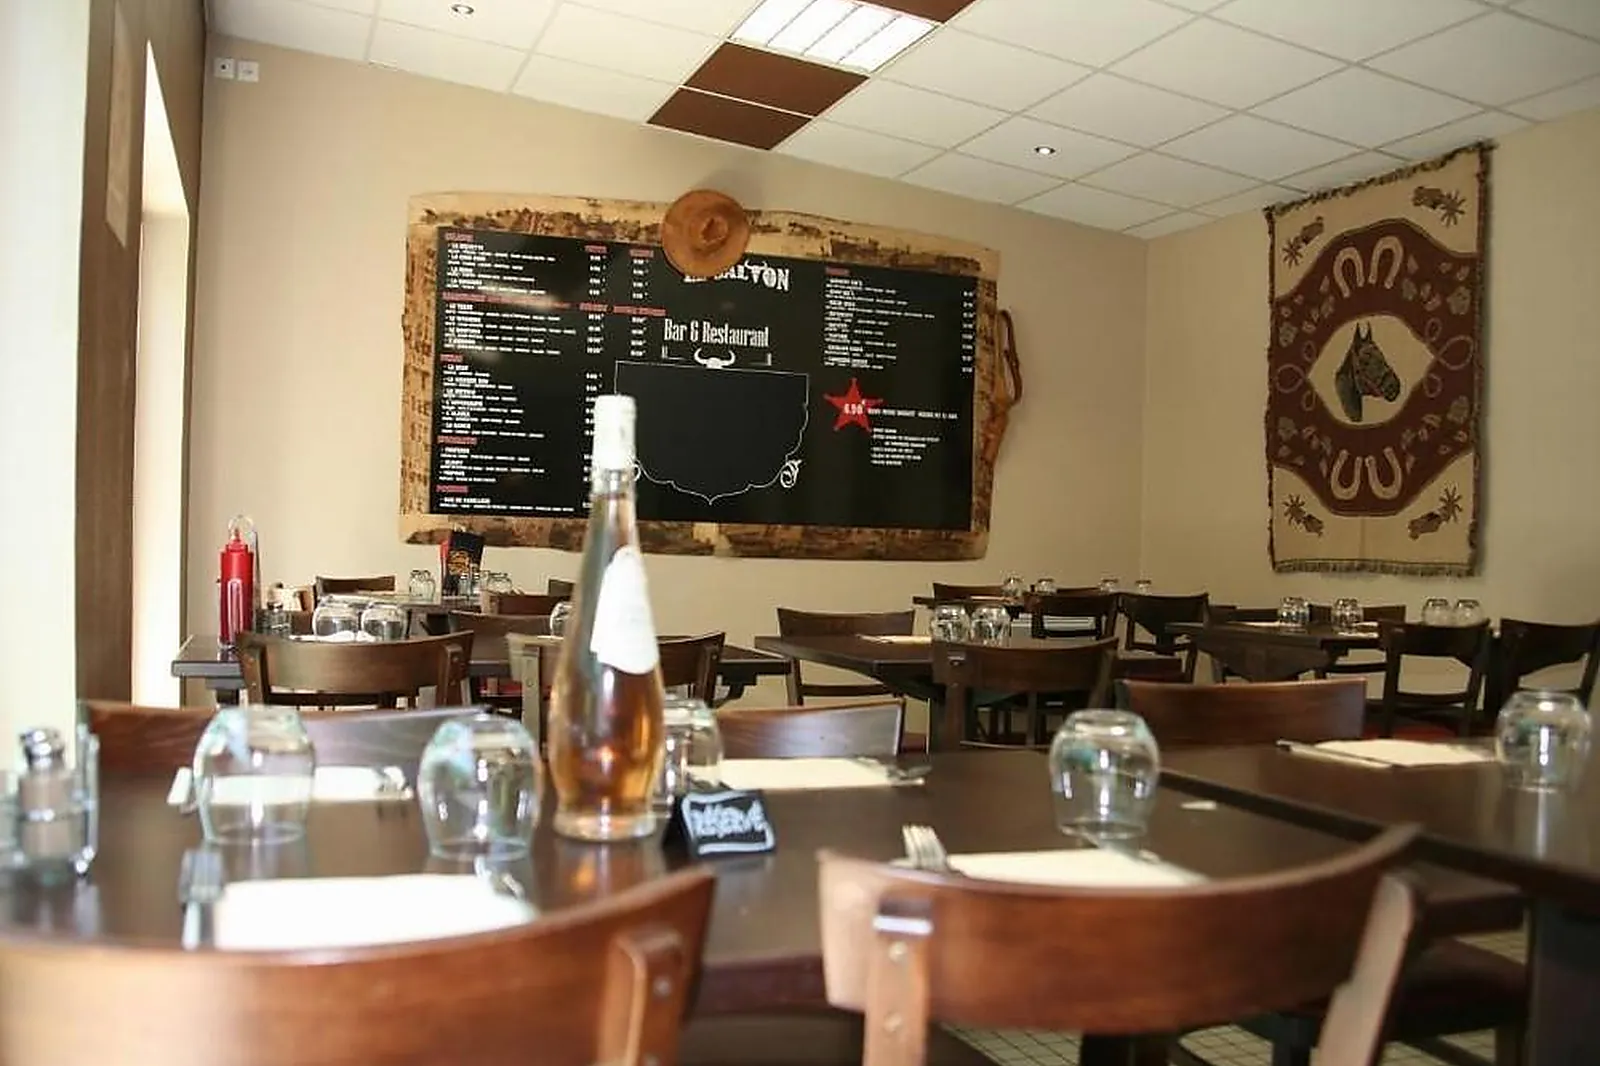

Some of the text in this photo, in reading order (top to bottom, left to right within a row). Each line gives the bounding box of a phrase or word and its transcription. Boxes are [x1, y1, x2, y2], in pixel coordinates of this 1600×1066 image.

[664, 318, 687, 340] Bar
[690, 320, 699, 342] &
[702, 321, 769, 347] Restaurant
